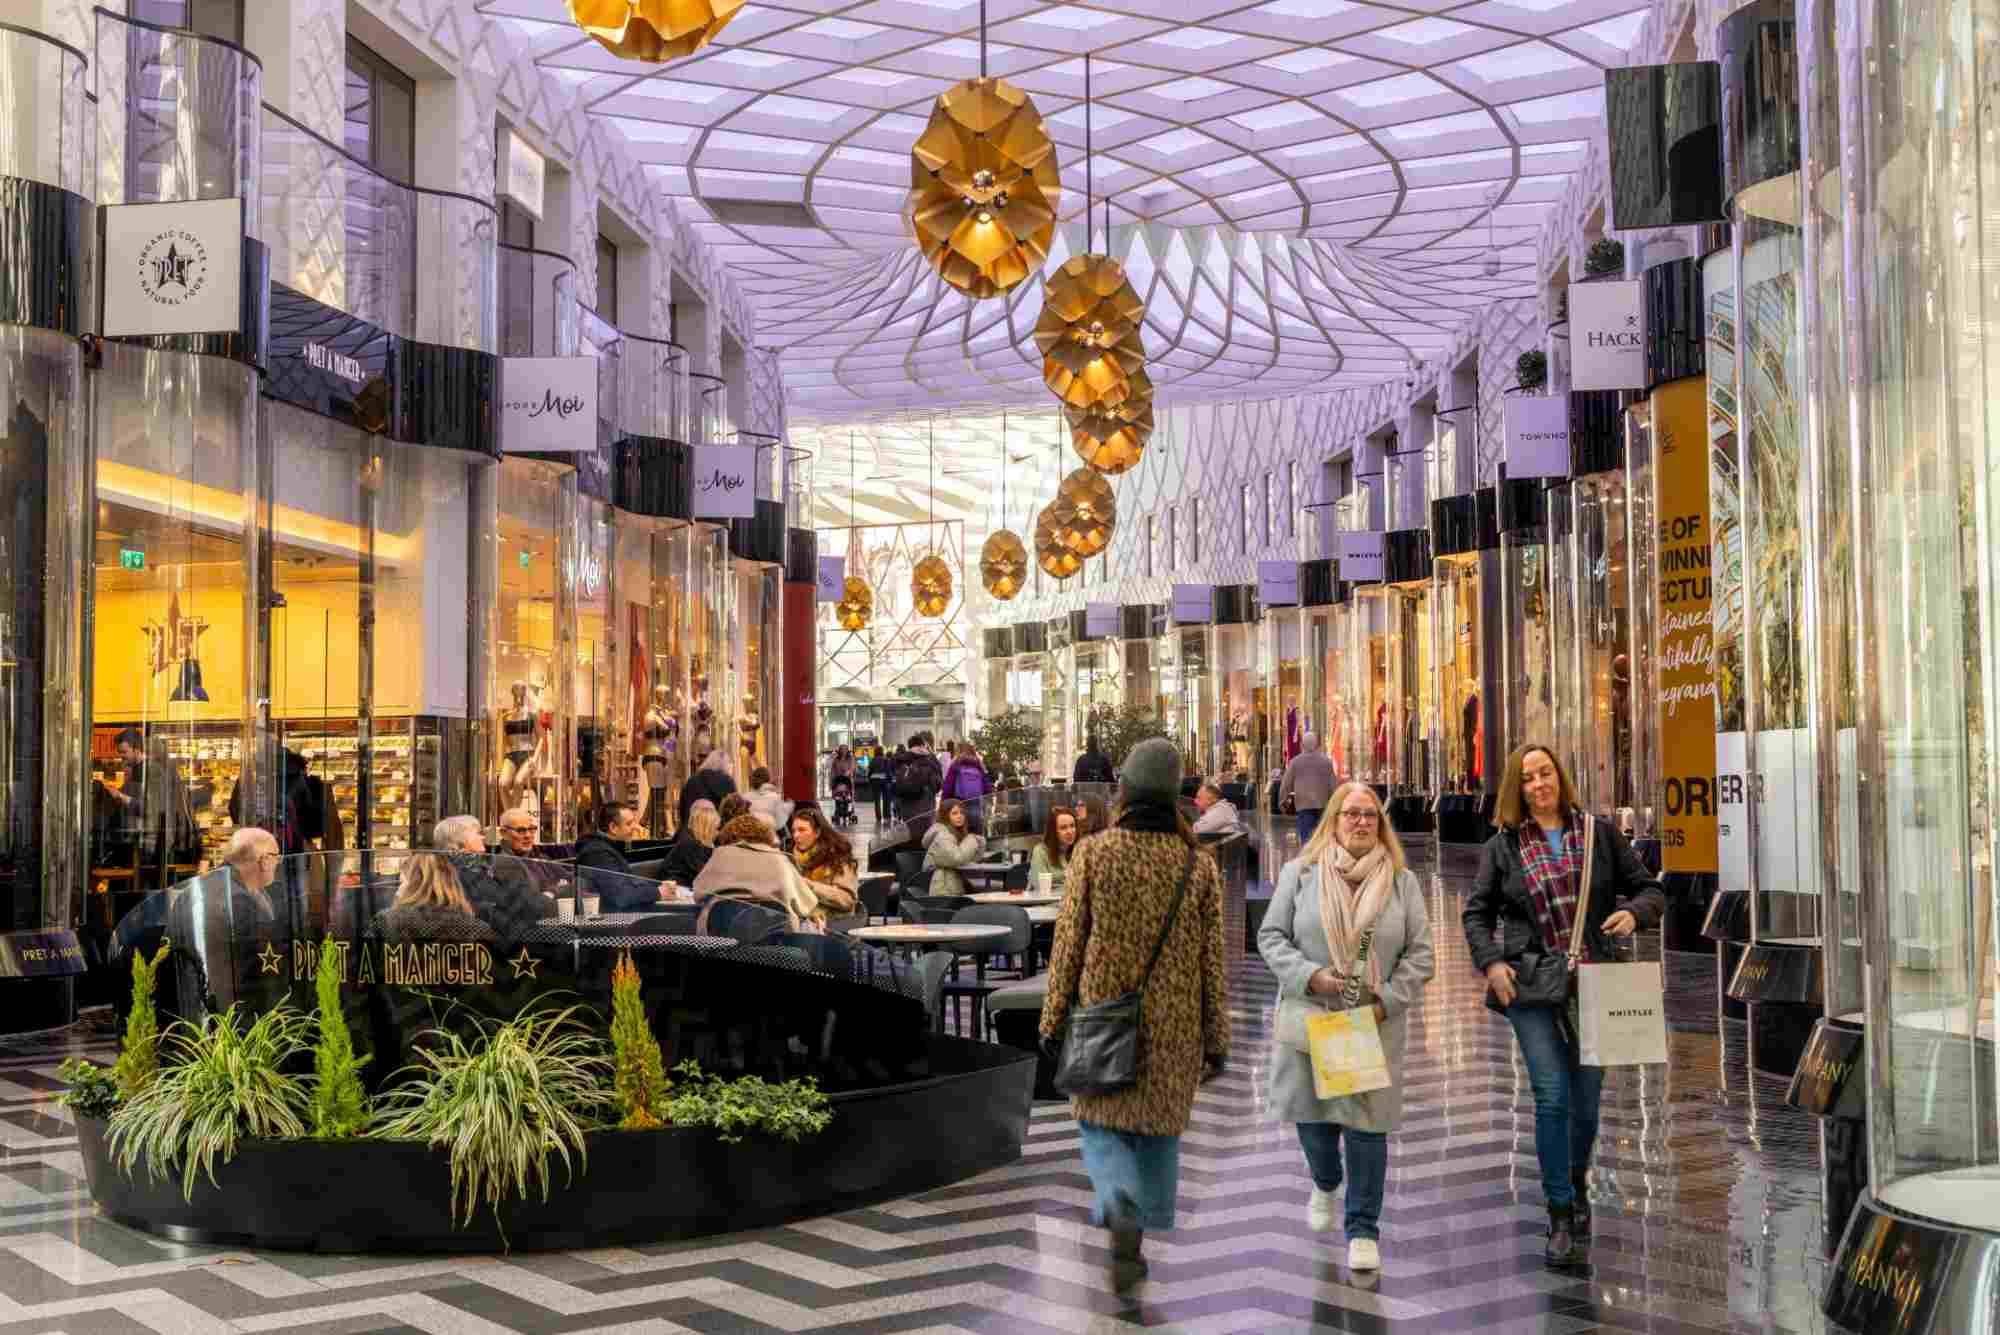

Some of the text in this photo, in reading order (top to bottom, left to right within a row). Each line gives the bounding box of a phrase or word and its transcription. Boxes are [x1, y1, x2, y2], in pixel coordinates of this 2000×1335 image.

[1587, 331, 1641, 347] HACK
[528, 388, 585, 420] Moi
[1671, 515, 1700, 539] OF
[293, 939, 494, 985] PRT A MANGER
